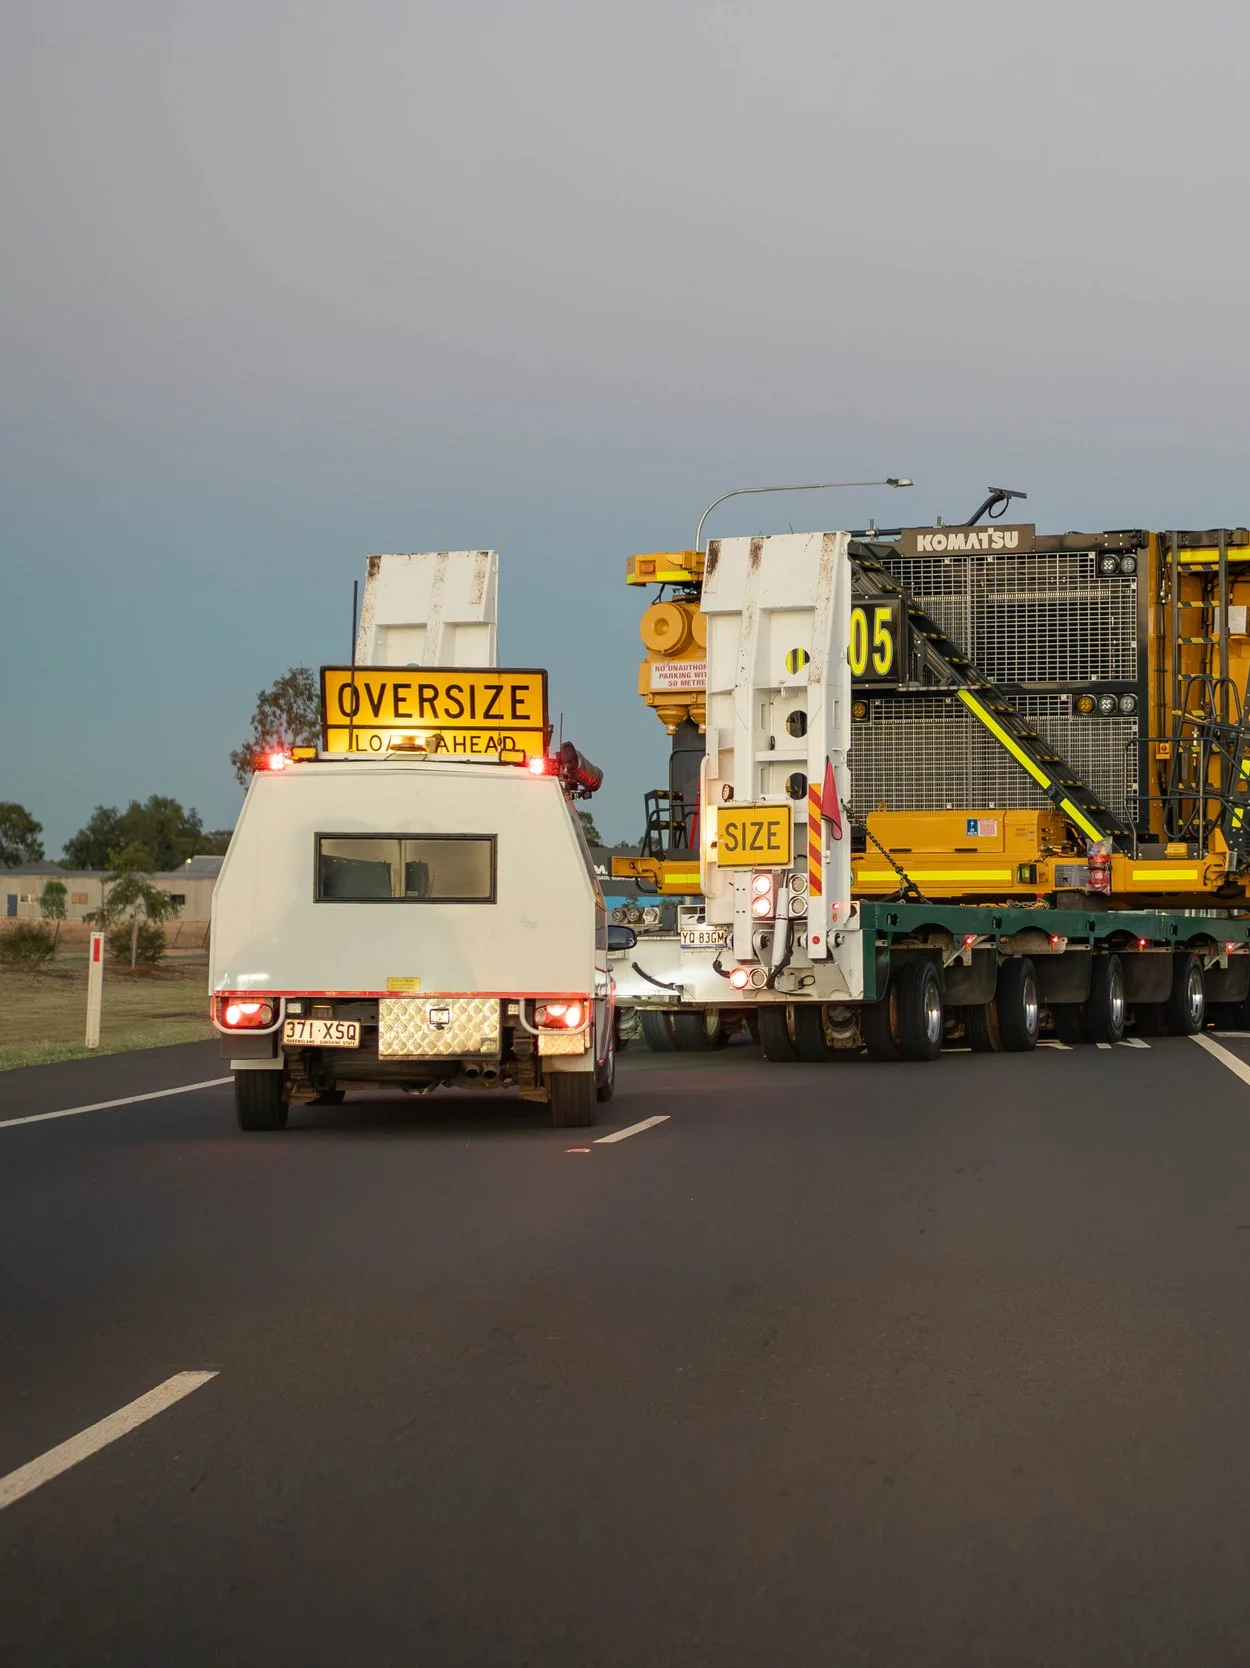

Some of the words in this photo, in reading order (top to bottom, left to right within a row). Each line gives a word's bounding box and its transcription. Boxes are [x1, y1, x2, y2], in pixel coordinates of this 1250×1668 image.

[916, 527, 1019, 552] KOMATSU
[659, 672, 691, 680] PARKING
[694, 671, 707, 679] WIT
[668, 663, 707, 671] UNAUTHOR
[680, 679, 706, 687] METRE
[337, 682, 531, 720] OVERSIZE
[435, 735, 516, 753] AHEAD
[724, 821, 780, 852] SIZE
